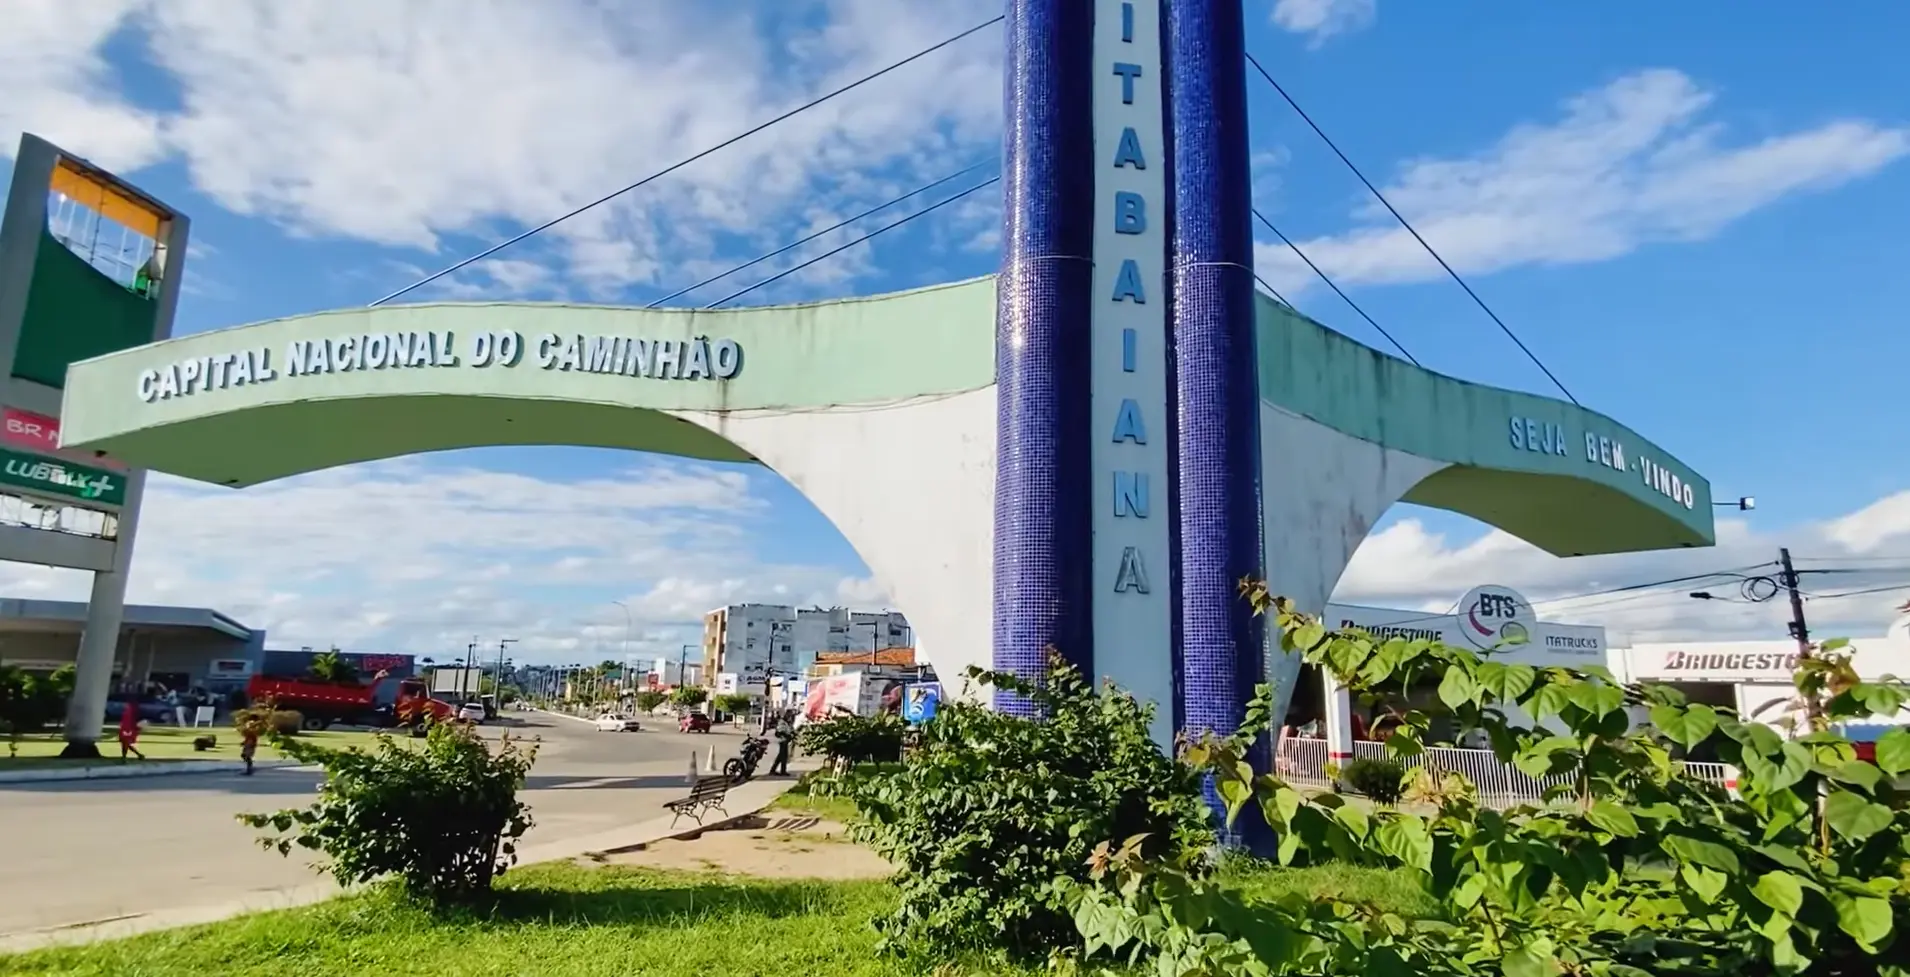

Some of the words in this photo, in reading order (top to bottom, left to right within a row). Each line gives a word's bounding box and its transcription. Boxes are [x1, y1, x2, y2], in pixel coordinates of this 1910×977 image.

[1111, 2, 1150, 594] ITABAIANA
[137, 346, 277, 403] CAPITAL
[285, 331, 460, 376] NACIONAL
[470, 329, 524, 368] DO
[535, 332, 744, 381] CAMINHÃO
[1509, 416, 1568, 456] SEJA
[1480, 593, 1515, 618] BTS
[1341, 620, 1442, 643] BDGESTONE
[1546, 635, 1598, 649] ITATRUCKS
